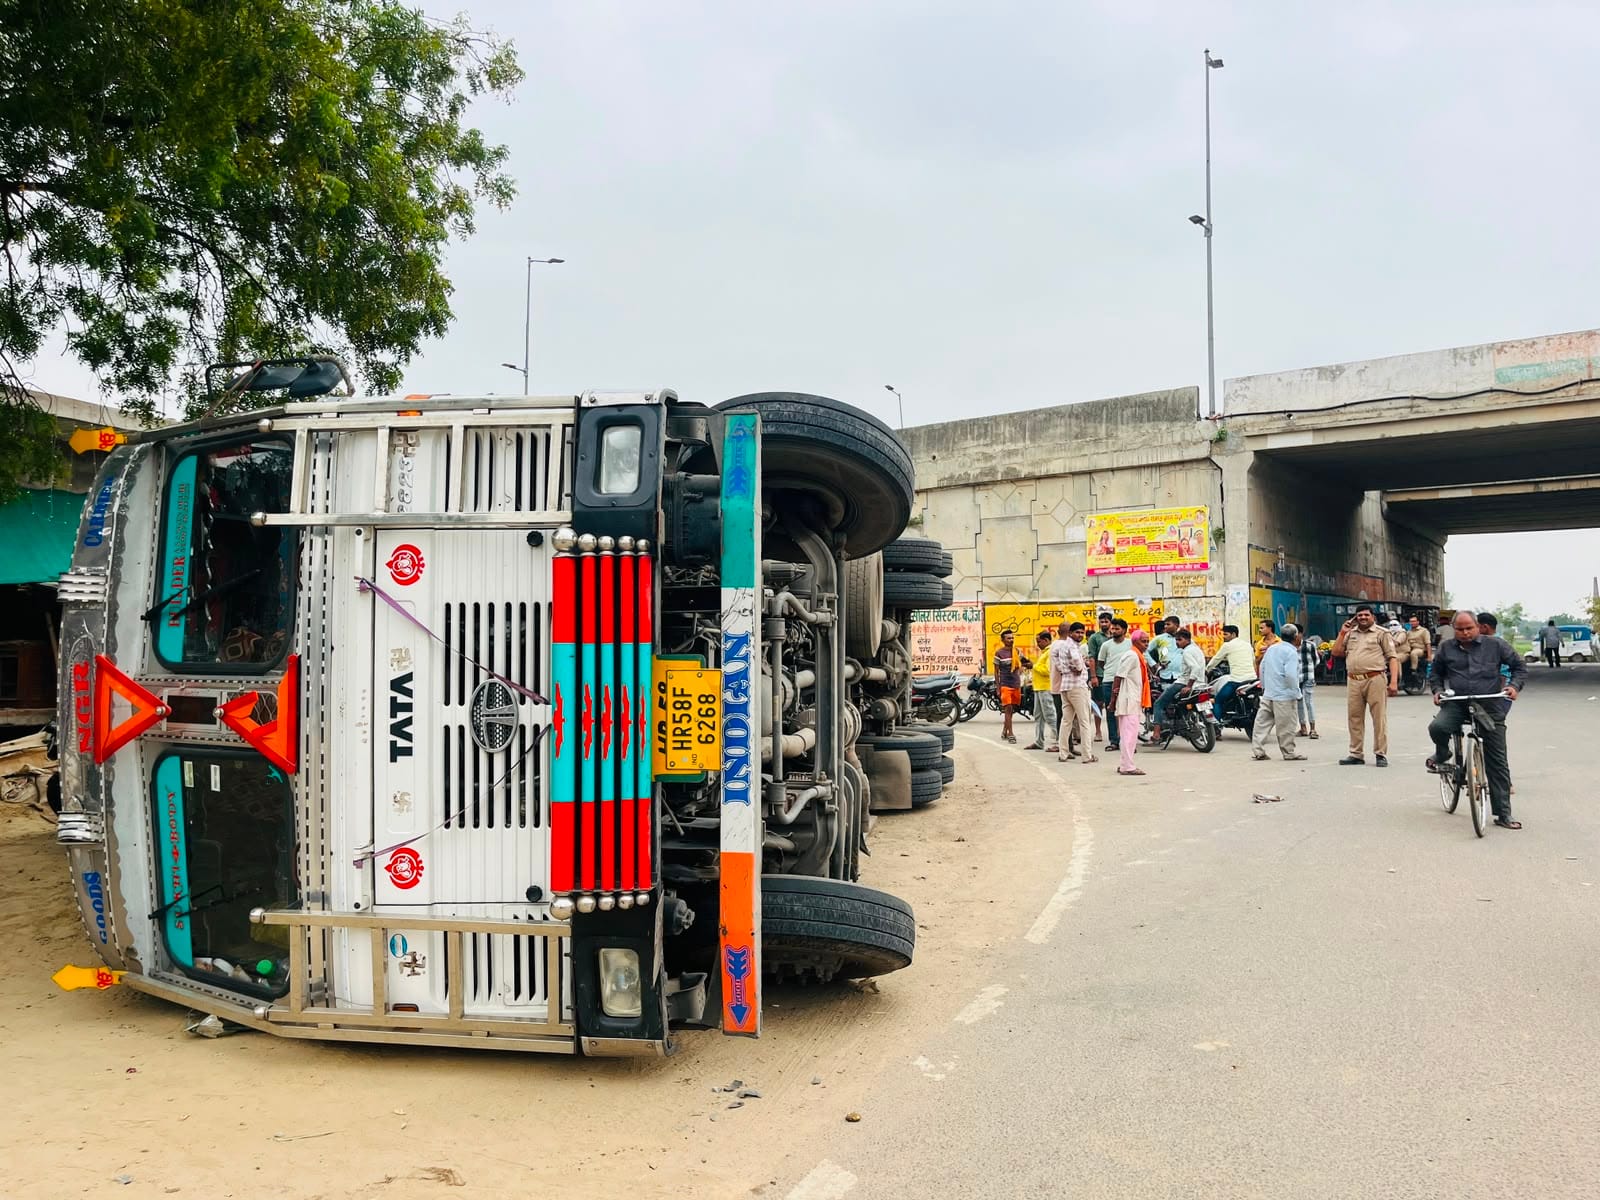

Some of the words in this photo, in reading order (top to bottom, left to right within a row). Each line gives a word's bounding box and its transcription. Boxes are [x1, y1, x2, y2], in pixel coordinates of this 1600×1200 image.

[1251, 605, 1271, 620] GREEN
[73, 661, 93, 754] NGR
[390, 672, 413, 763] TATA
[671, 687, 692, 750] HR58F
[697, 694, 717, 744] 6268
[721, 631, 752, 806] INDIAN
[165, 785, 180, 843] BODY
[82, 871, 107, 944] GOODS
[734, 979, 743, 1005] GOOD
